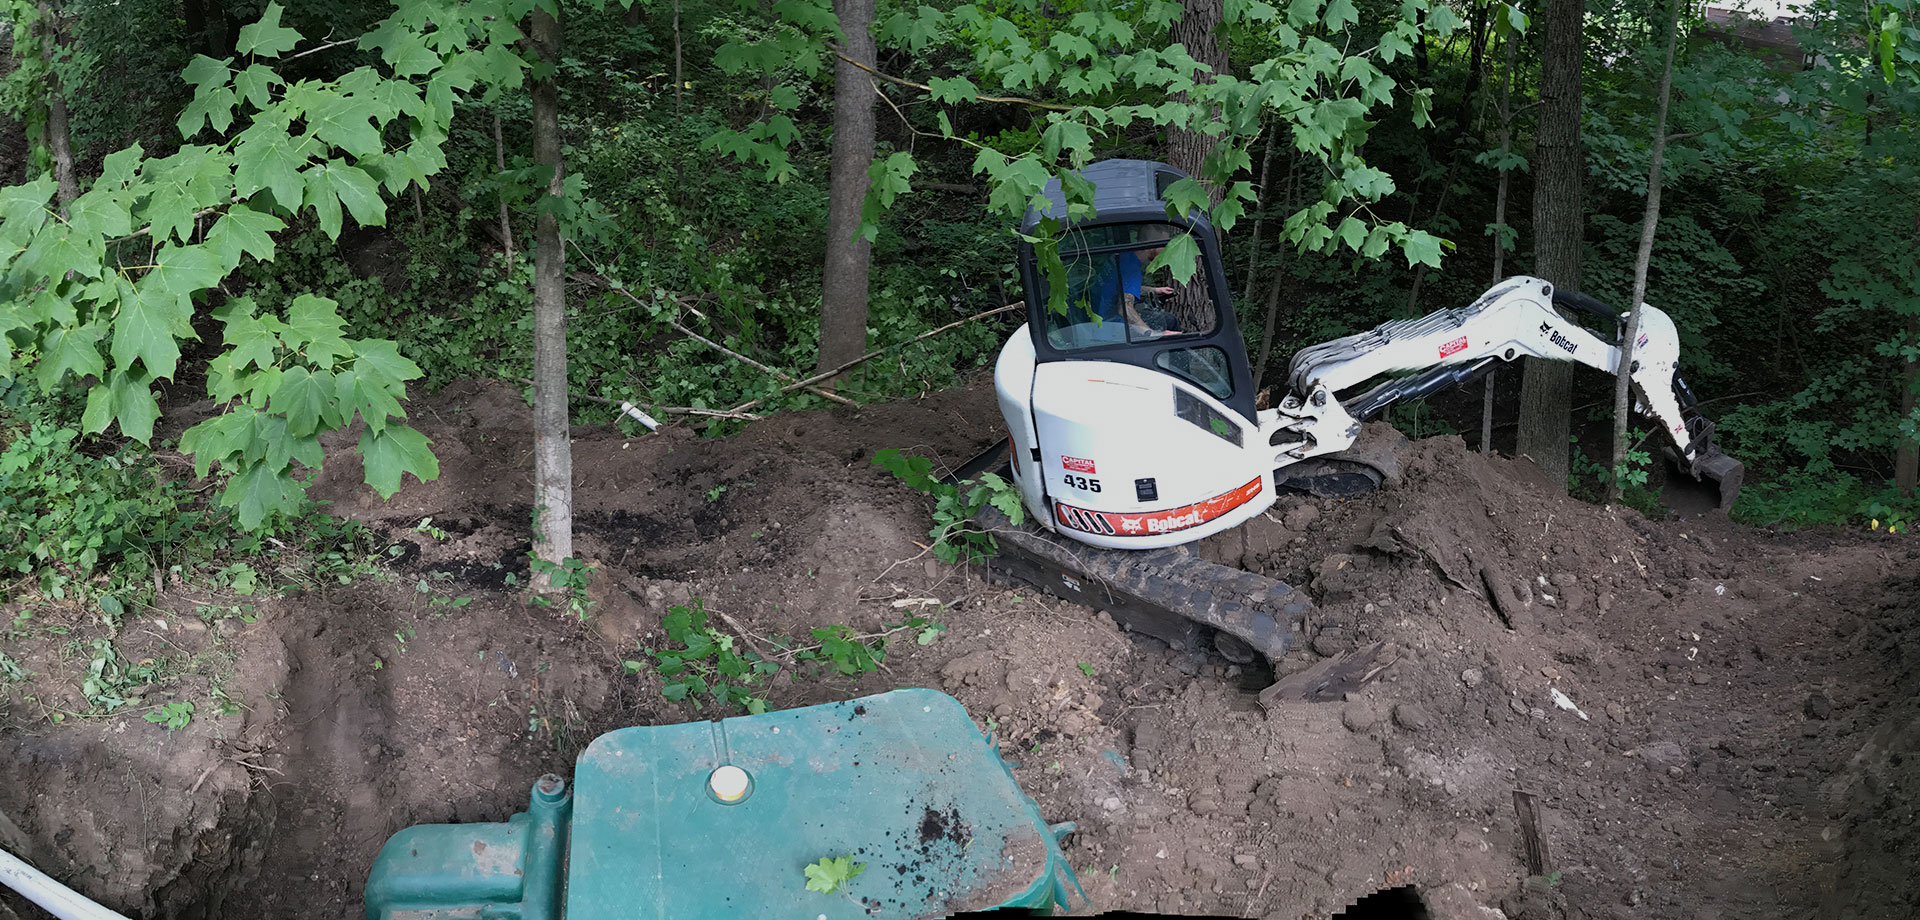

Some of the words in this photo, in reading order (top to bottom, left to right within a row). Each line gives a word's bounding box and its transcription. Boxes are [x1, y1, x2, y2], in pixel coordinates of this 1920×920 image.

[1550, 330, 1578, 354] Bobcat
[1063, 456, 1095, 467] CAPITAL
[1064, 474, 1101, 493] 435
[1147, 510, 1200, 532] Bobcat
